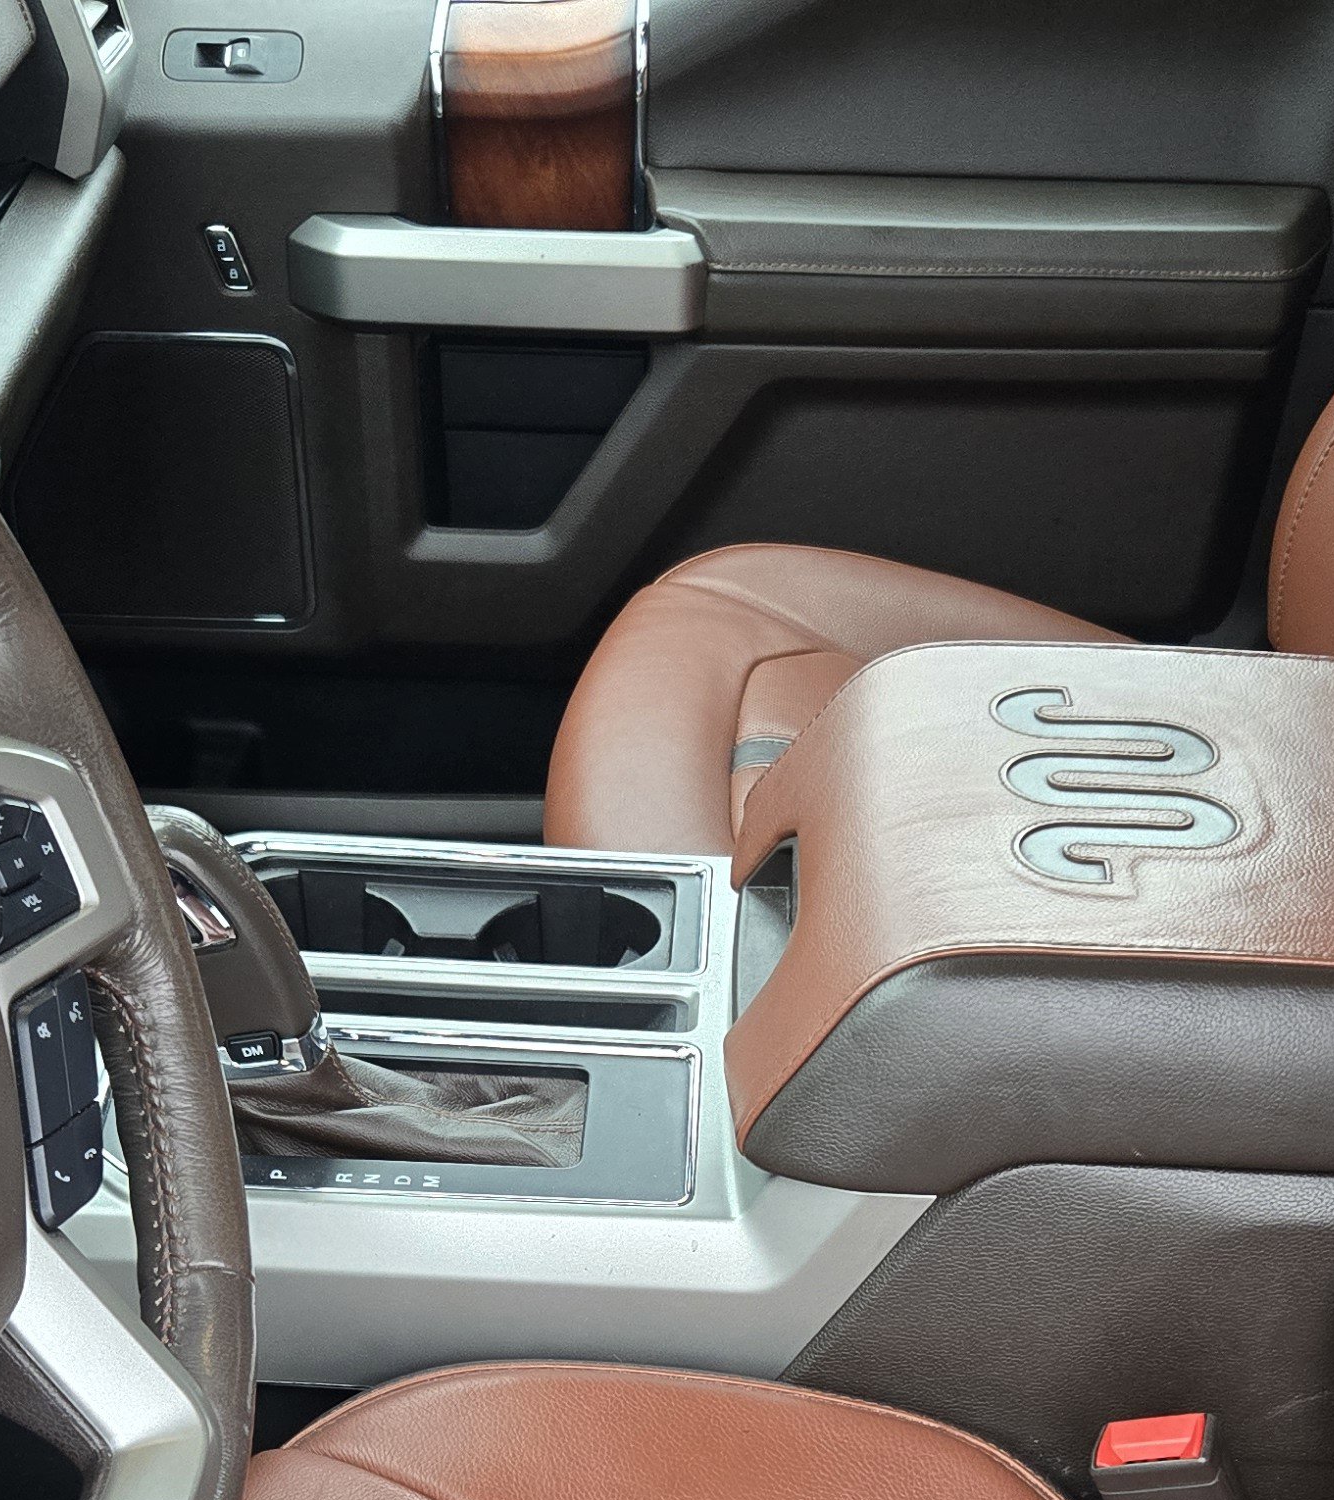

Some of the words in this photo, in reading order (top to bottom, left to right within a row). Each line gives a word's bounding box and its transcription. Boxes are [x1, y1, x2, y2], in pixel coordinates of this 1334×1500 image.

[22, 894, 42, 908] VOL
[270, 1169, 287, 1181] P
[335, 1172, 353, 1183] R
[363, 1173, 381, 1184] N
[394, 1175, 411, 1186] D
[423, 1175, 441, 1188] M
